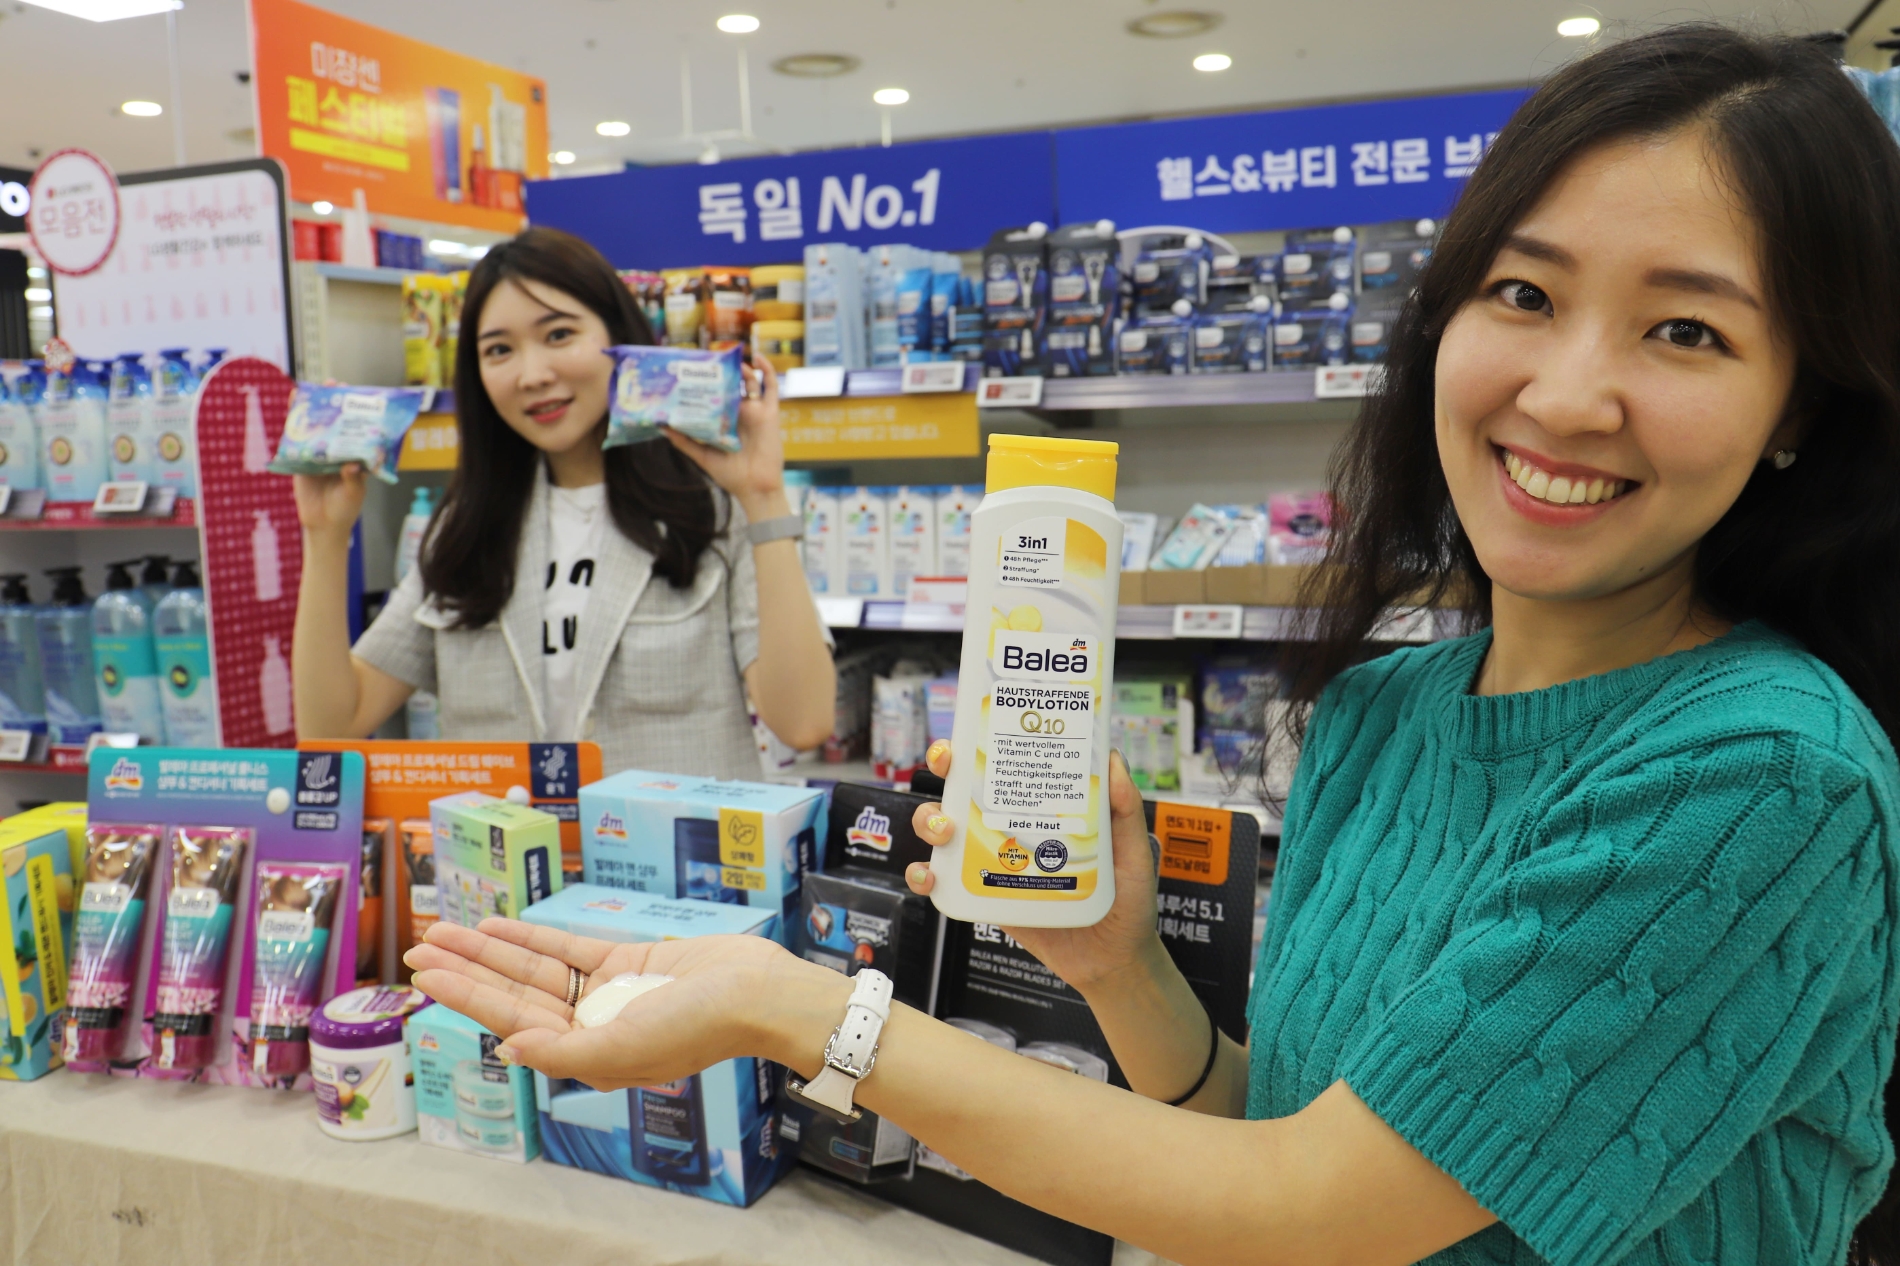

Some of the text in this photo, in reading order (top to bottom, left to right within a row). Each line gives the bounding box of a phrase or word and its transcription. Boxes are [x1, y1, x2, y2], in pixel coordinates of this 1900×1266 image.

[311, 41, 381, 93] 미장센
[286, 75, 408, 148] 페스티벌
[1156, 144, 1337, 201] 헬스&뷰티
[1350, 138, 1431, 187] 전문
[698, 167, 941, 244] 독일 No.1
[38, 197, 108, 239] 모음전
[1018, 535, 1048, 550] 3in1
[1072, 638, 1086, 647] dm
[1003, 645, 1088, 674] Balea
[997, 686, 1090, 699] HAUTSTRAFFENDE
[996, 696, 1089, 711] BODYLOTION
[1020, 710, 1065, 735] Q10
[1015, 740, 1065, 749] wertvollem
[997, 747, 1032, 757] Vitamin
[1043, 750, 1061, 758] und
[1063, 751, 1080, 759] Q10
[112, 757, 139, 777] dm
[996, 759, 1053, 769] erfrischende
[995, 767, 1083, 781] Feuchtigkeitspflege
[995, 780, 1023, 788] strafft
[1045, 782, 1073, 791] festigt
[993, 797, 999, 805] 2
[994, 788, 1084, 800] die Haut schon nach
[600, 812, 623, 829] dm
[857, 810, 888, 836] dm
[1008, 819, 1061, 830] jede Haut
[1165, 815, 1196, 831] 면도기
[1197, 819, 1213, 833] 1입
[998, 852, 1028, 860] VITAMIN
[1163, 856, 1194, 872] 면도날
[594, 858, 658, 879] 발레아 맨 샴푸
[627, 878, 647, 892] 세트
[726, 871, 744, 886] 2입
[1199, 900, 1225, 921] 5.1
[970, 948, 1054, 976] BALEA MEN REVOLUTION
[968, 959, 1067, 990] RAZOR & RAZOR BLADES SET
[644, 1101, 687, 1119] SHAMPOO
